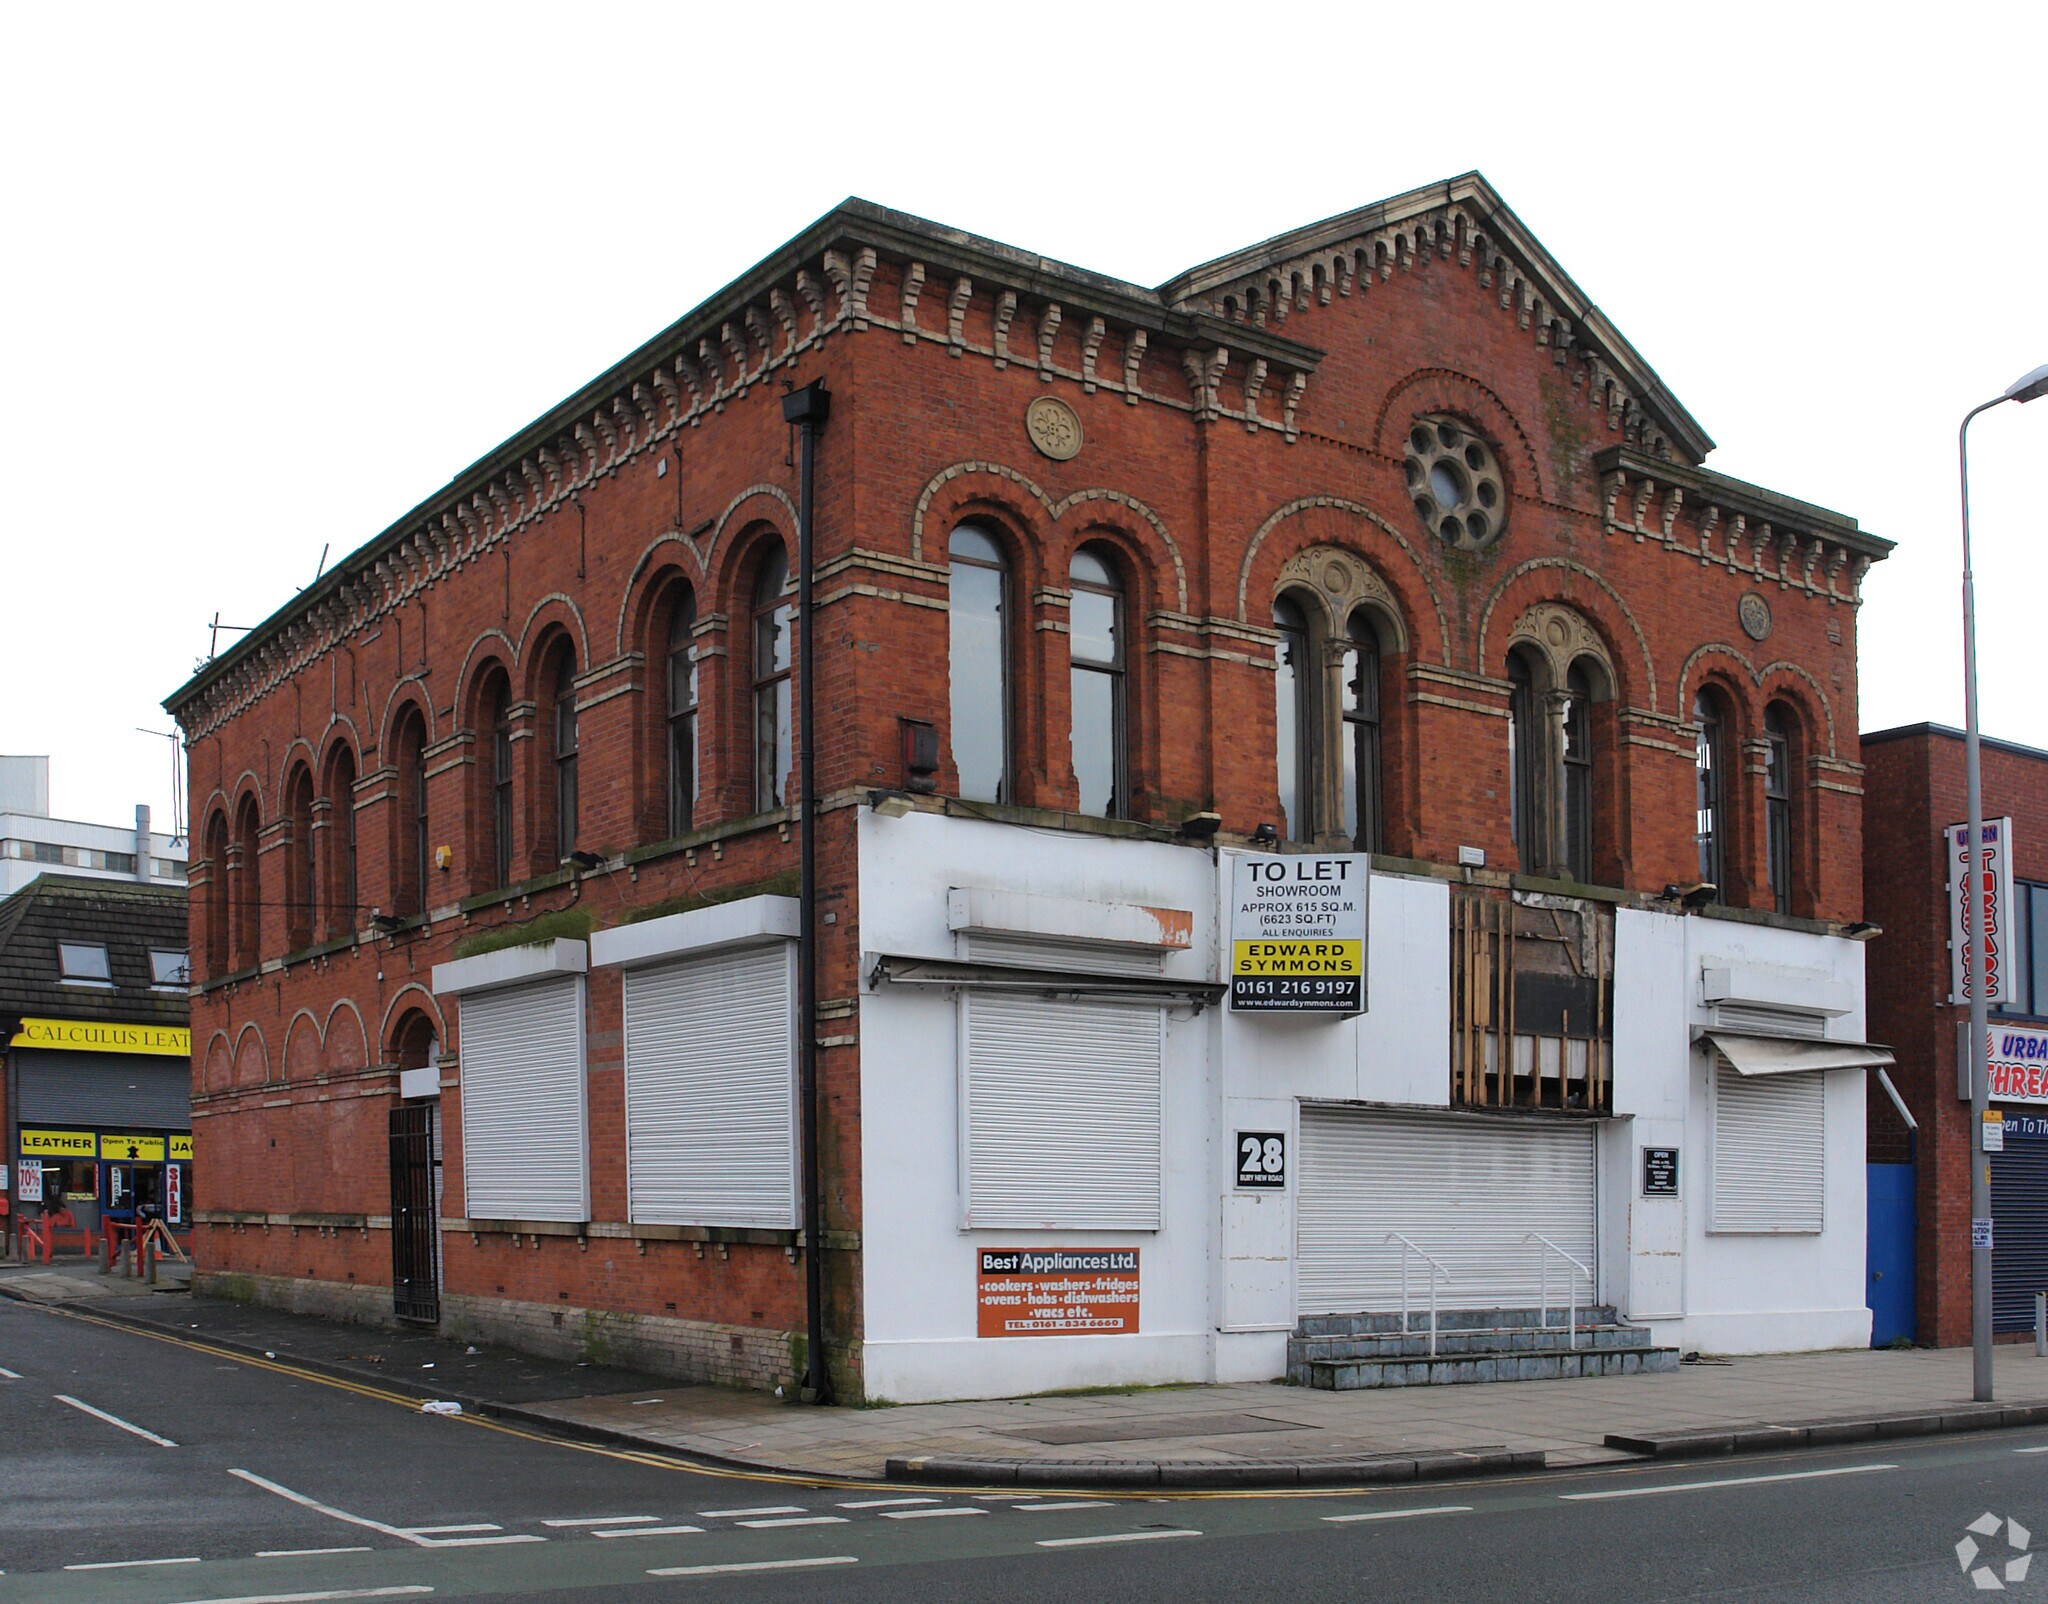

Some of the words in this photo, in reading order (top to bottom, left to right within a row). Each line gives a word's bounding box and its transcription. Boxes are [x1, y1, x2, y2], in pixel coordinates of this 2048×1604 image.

[1957, 825, 1997, 847] UAN
[1247, 862, 1286, 882] TO
[1297, 861, 1352, 881] LET
[1256, 885, 1341, 897] SHOWROOM
[1241, 902, 1292, 913] APPROX
[1296, 902, 1317, 912] 615
[1321, 902, 1356, 912] SQ.M.
[1260, 914, 1291, 926] (6623
[1295, 914, 1336, 925] SQ.FT)
[1262, 929, 1278, 937] ALL
[1282, 929, 1333, 937] ENQUIRIES
[1249, 945, 1344, 956] EDWARD
[1240, 960, 1353, 971] SYMMONS
[1236, 982, 1274, 994] 0161
[1280, 982, 1310, 994] 216
[1316, 981, 1355, 994] 9197
[1238, 999, 1353, 1008] www.edwardsymmons.com
[27, 1025, 138, 1044] CALCULUS
[144, 1032, 190, 1047] LEAT
[2021, 1117, 2034, 1133] To
[23, 1137, 92, 1148] LEATHER
[103, 1138, 124, 1146] Open
[172, 1142, 193, 1152] JA
[1241, 1137, 1283, 1173] 28
[20, 1169, 40, 1186] 70%
[169, 1168, 178, 1217] SALE
[983, 1255, 1018, 1269] Best
[1021, 1253, 1108, 1273] Appliances
[1110, 1252, 1137, 1269] Ltd.
[1067, 1306, 1093, 1318] etc.
